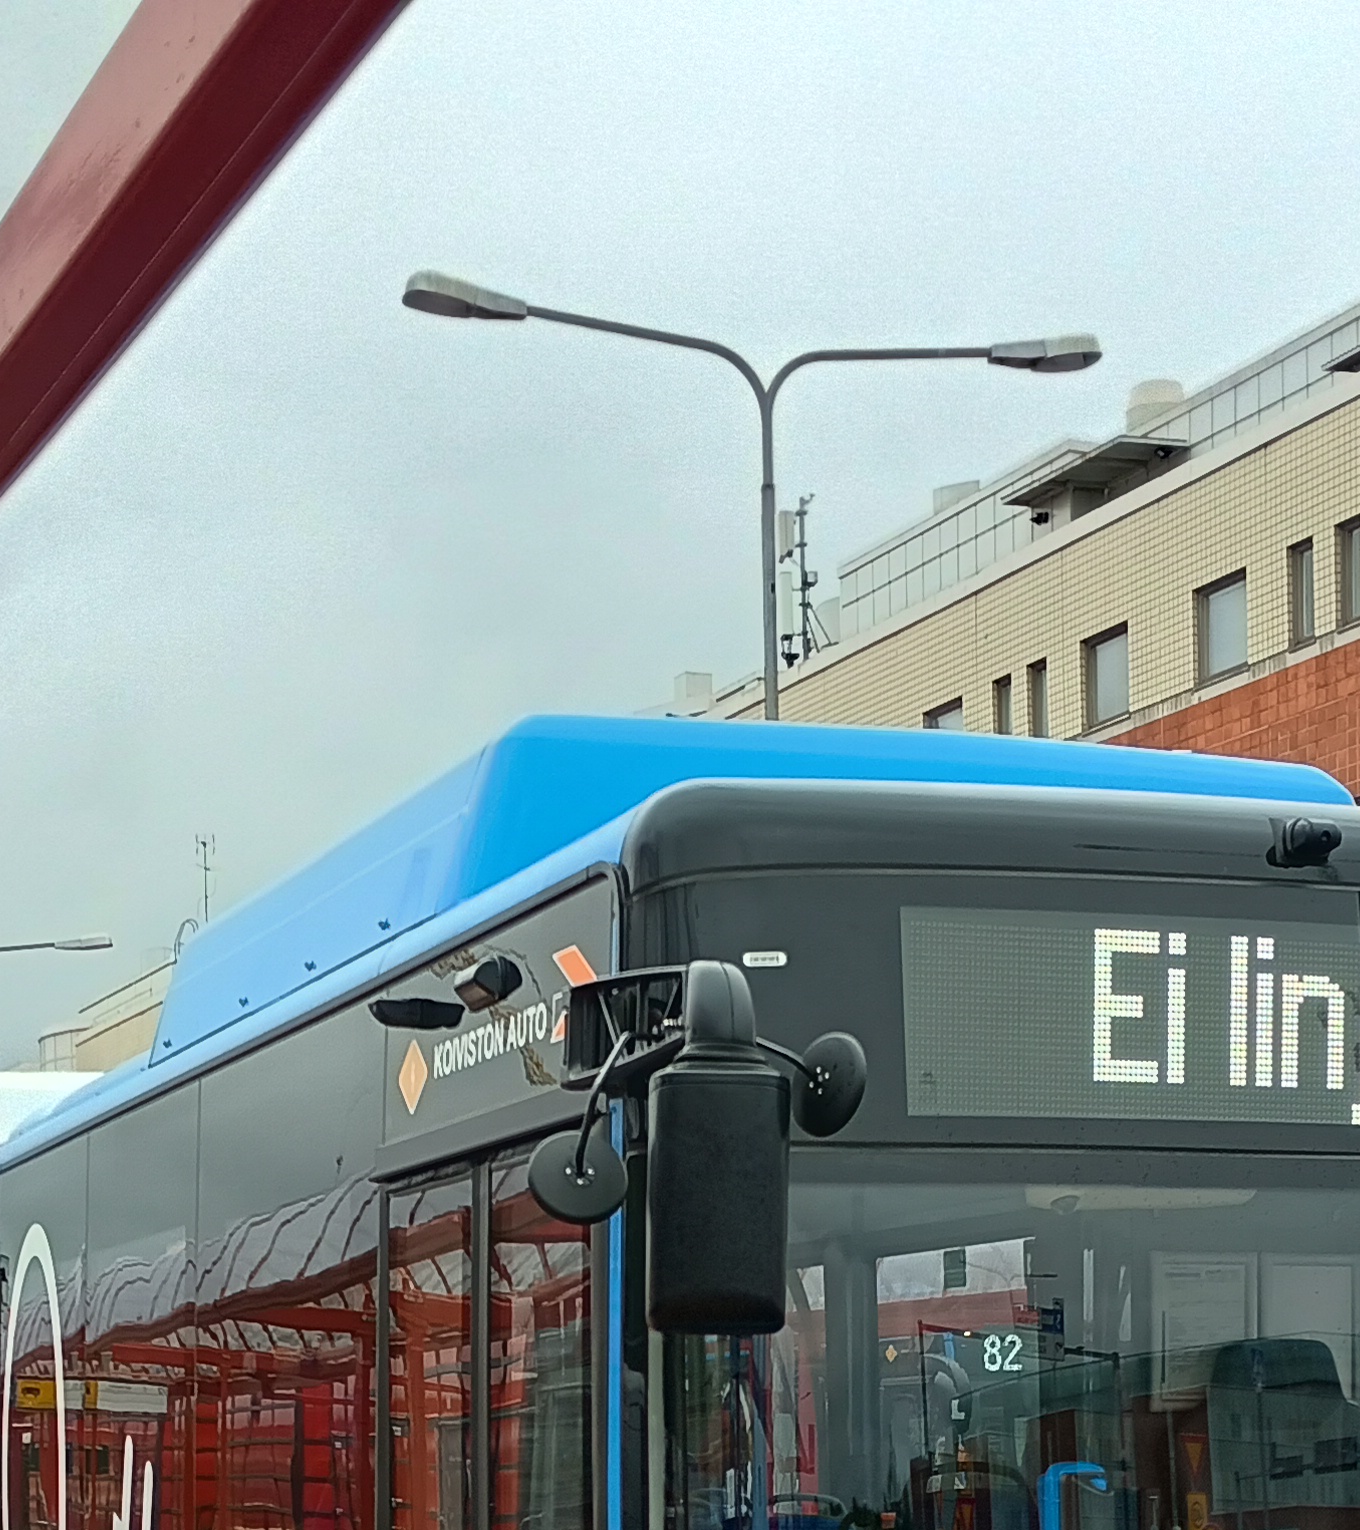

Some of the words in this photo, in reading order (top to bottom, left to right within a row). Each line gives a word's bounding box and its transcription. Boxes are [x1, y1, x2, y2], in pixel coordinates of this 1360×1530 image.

[506, 1003, 548, 1050] AUTO
[1094, 928, 1186, 1085] Ei
[983, 1334, 1023, 1372] 82
